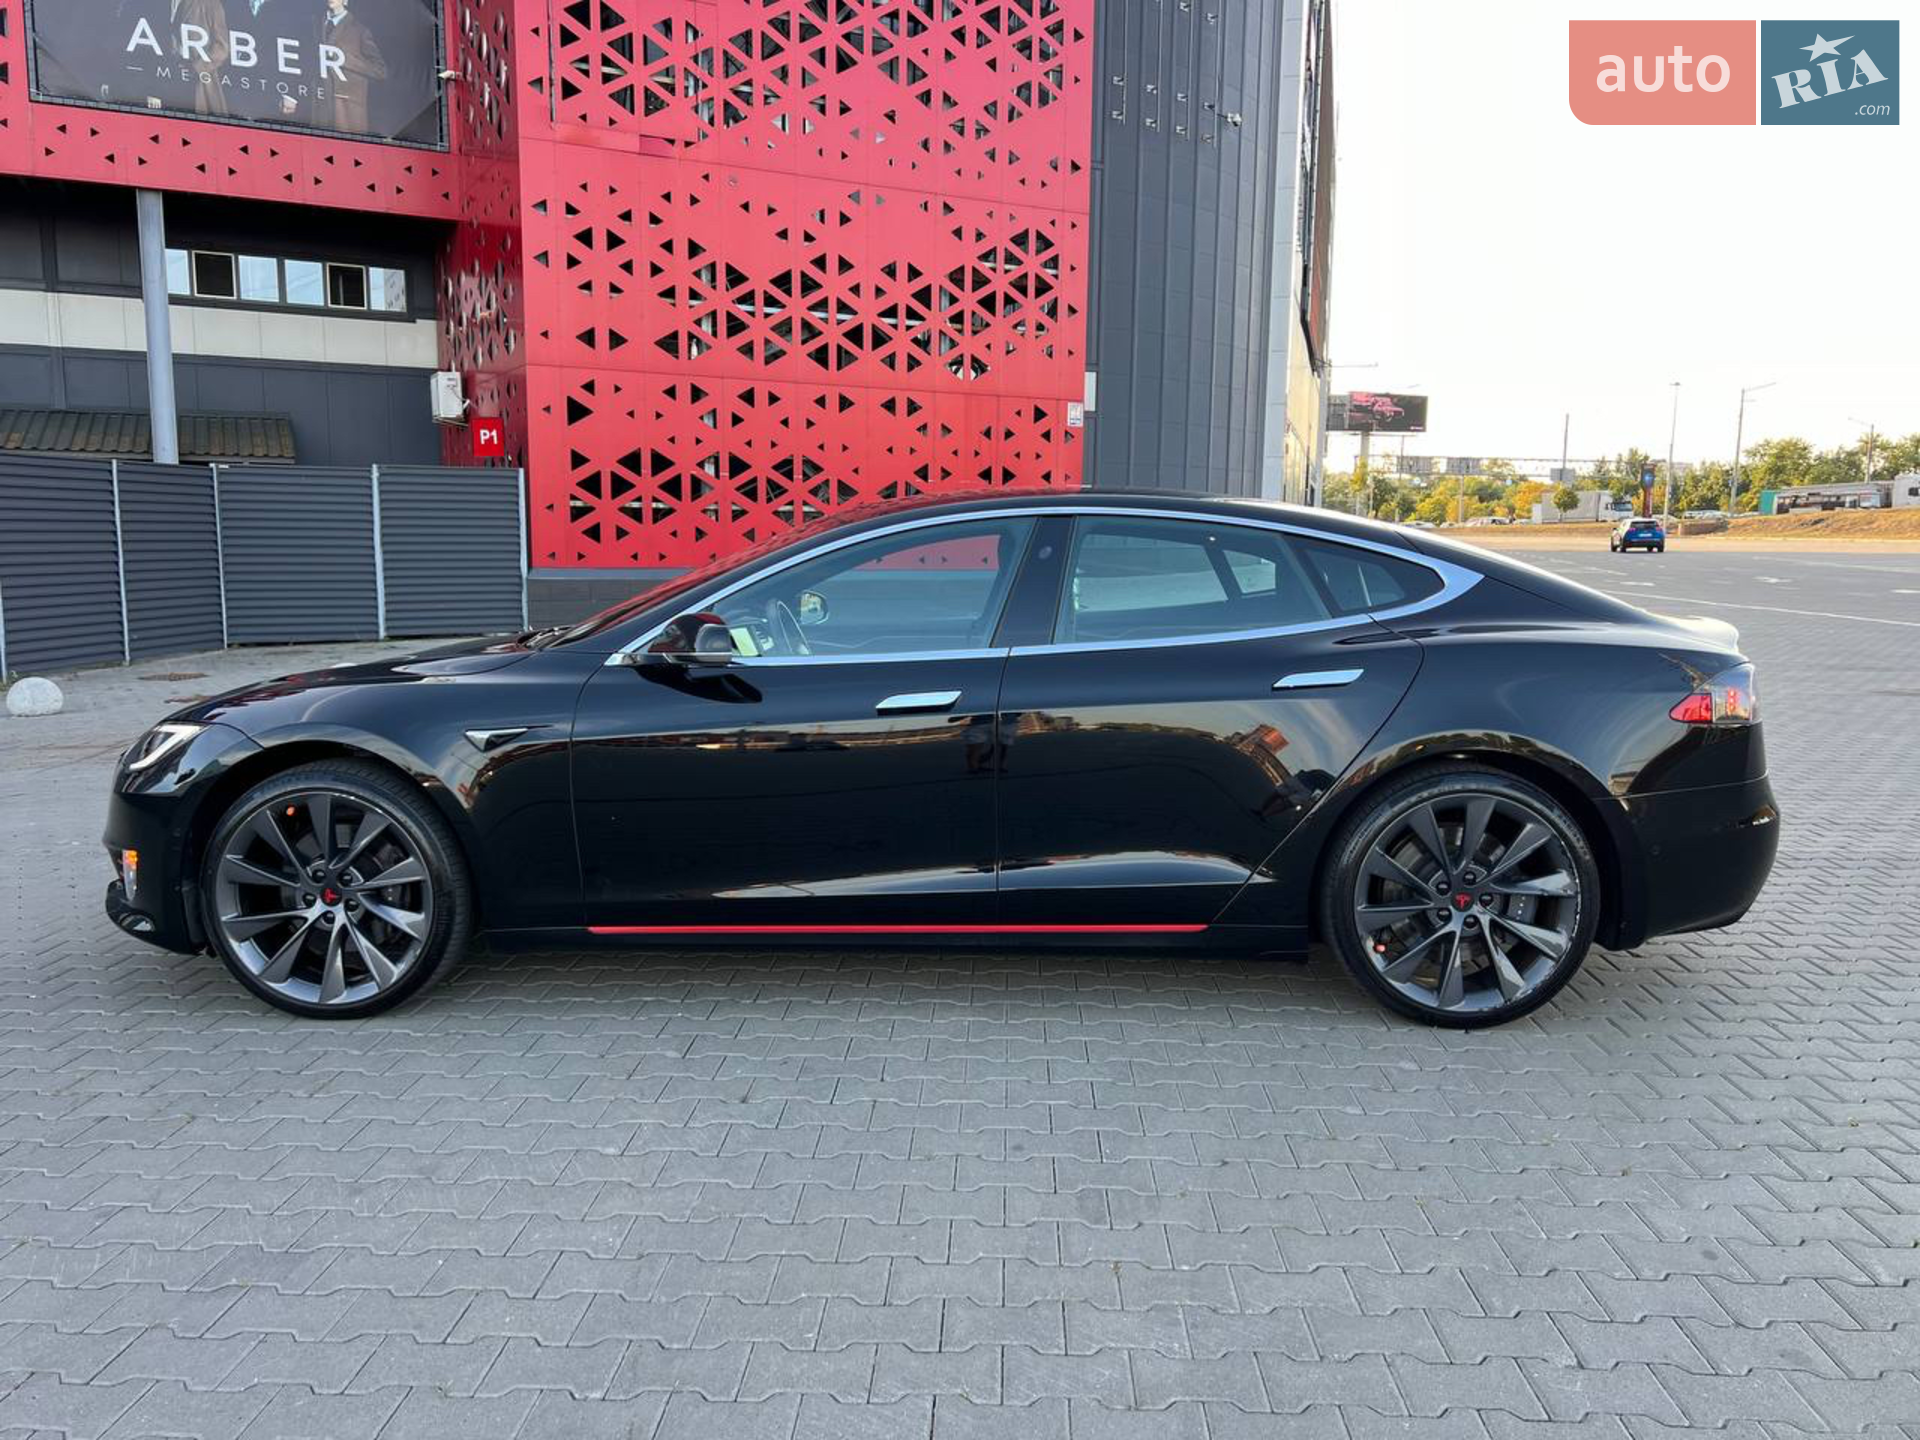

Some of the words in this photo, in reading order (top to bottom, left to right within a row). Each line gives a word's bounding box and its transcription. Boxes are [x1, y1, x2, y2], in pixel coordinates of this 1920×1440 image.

[126, 17, 348, 82] ARBER
[156, 66, 326, 100] MEGASTORE
[480, 428, 498, 445] P1
